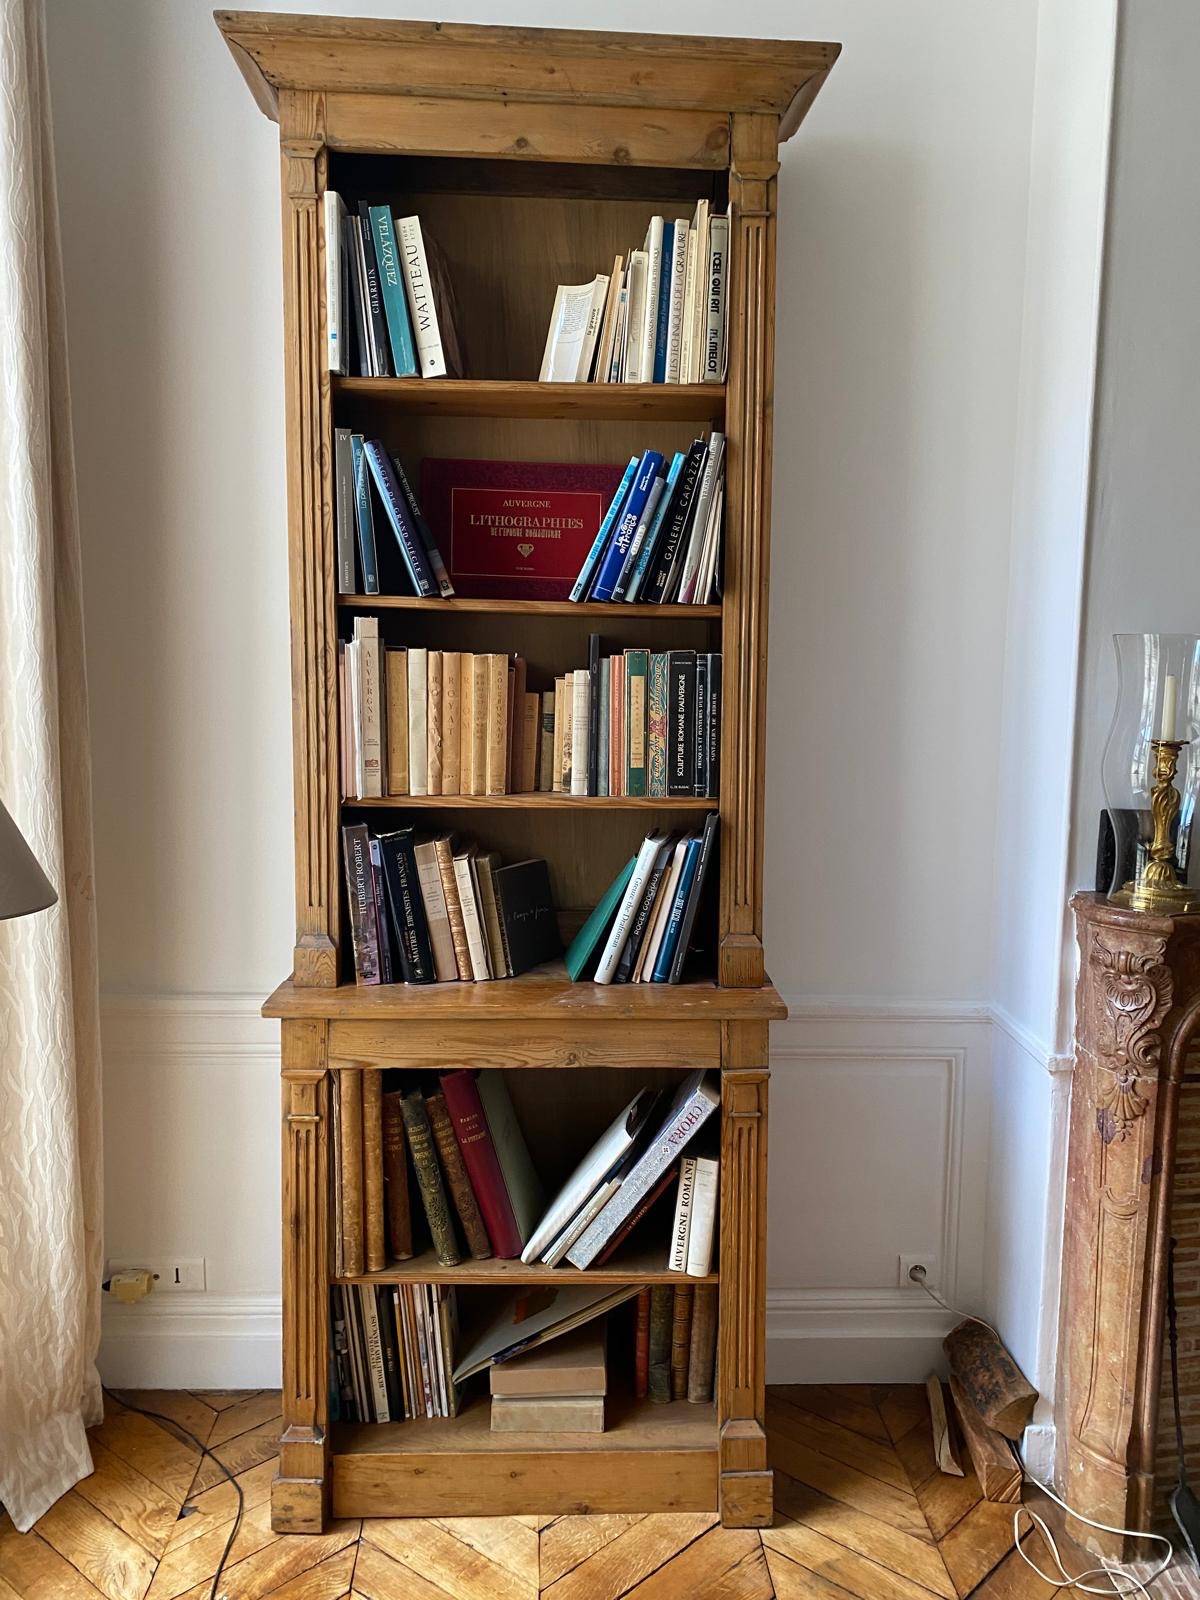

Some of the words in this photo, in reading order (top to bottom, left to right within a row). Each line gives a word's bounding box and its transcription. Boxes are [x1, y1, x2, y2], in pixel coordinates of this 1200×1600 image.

[378, 215, 398, 287] VELÁZQUEZ
[675, 231, 686, 273] GRAVURE
[369, 268, 380, 314] CHARDIN
[406, 245, 431, 331] WATTEAU
[673, 286, 682, 298] DE
[674, 273, 683, 285] LA
[711, 279, 721, 298] QUI
[710, 298, 720, 314] RIT
[670, 301, 682, 356] TECHNIQUES
[669, 357, 677, 372] LES
[394, 507, 409, 538] GRAND
[470, 514, 584, 529] LITHOGRAPHIES
[502, 499, 551, 509] AUVERGNE
[664, 515, 684, 560] GALERIE
[679, 452, 702, 507] CAPAZZA
[619, 513, 633, 536] verre
[620, 545, 628, 554] en
[624, 514, 638, 547] France
[365, 650, 374, 723] AUVERGNE
[447, 677, 456, 735] ROYAT
[353, 838, 364, 876] ROBERT
[354, 876, 368, 915] HUBERT
[624, 901, 633, 913] the
[629, 877, 642, 900] Greuze
[634, 911, 647, 936] ROGER
[643, 871, 661, 911] GODCHAUX
[612, 912, 629, 948] Draftsman
[667, 1105, 703, 1145] CHORA
[674, 1213, 689, 1269] AUVERGNE
[682, 1159, 695, 1207] ROMANE
